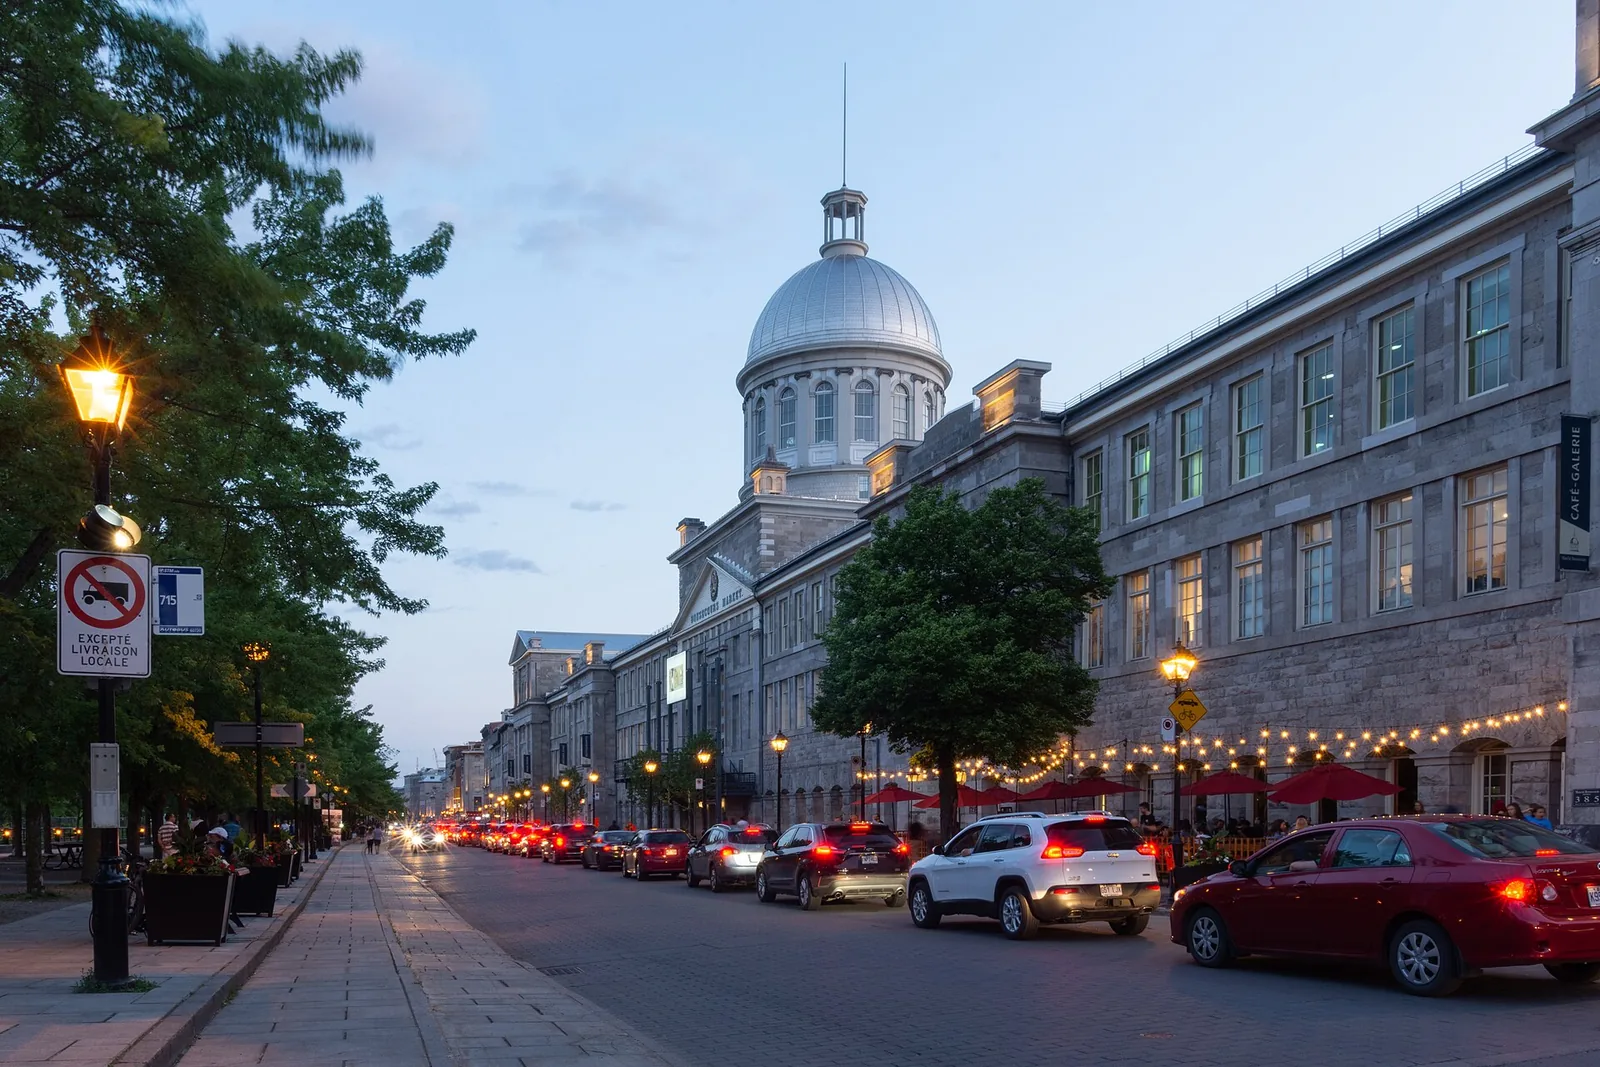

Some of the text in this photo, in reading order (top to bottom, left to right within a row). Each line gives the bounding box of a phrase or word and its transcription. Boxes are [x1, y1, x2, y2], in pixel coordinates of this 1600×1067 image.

[1570, 426, 1581, 520] CAFÉ-GALERIE
[160, 595, 176, 605] 715
[78, 633, 131, 645] EXCEPTÉ
[72, 644, 138, 657] LIVRAISON
[81, 656, 129, 667] LOCALE
